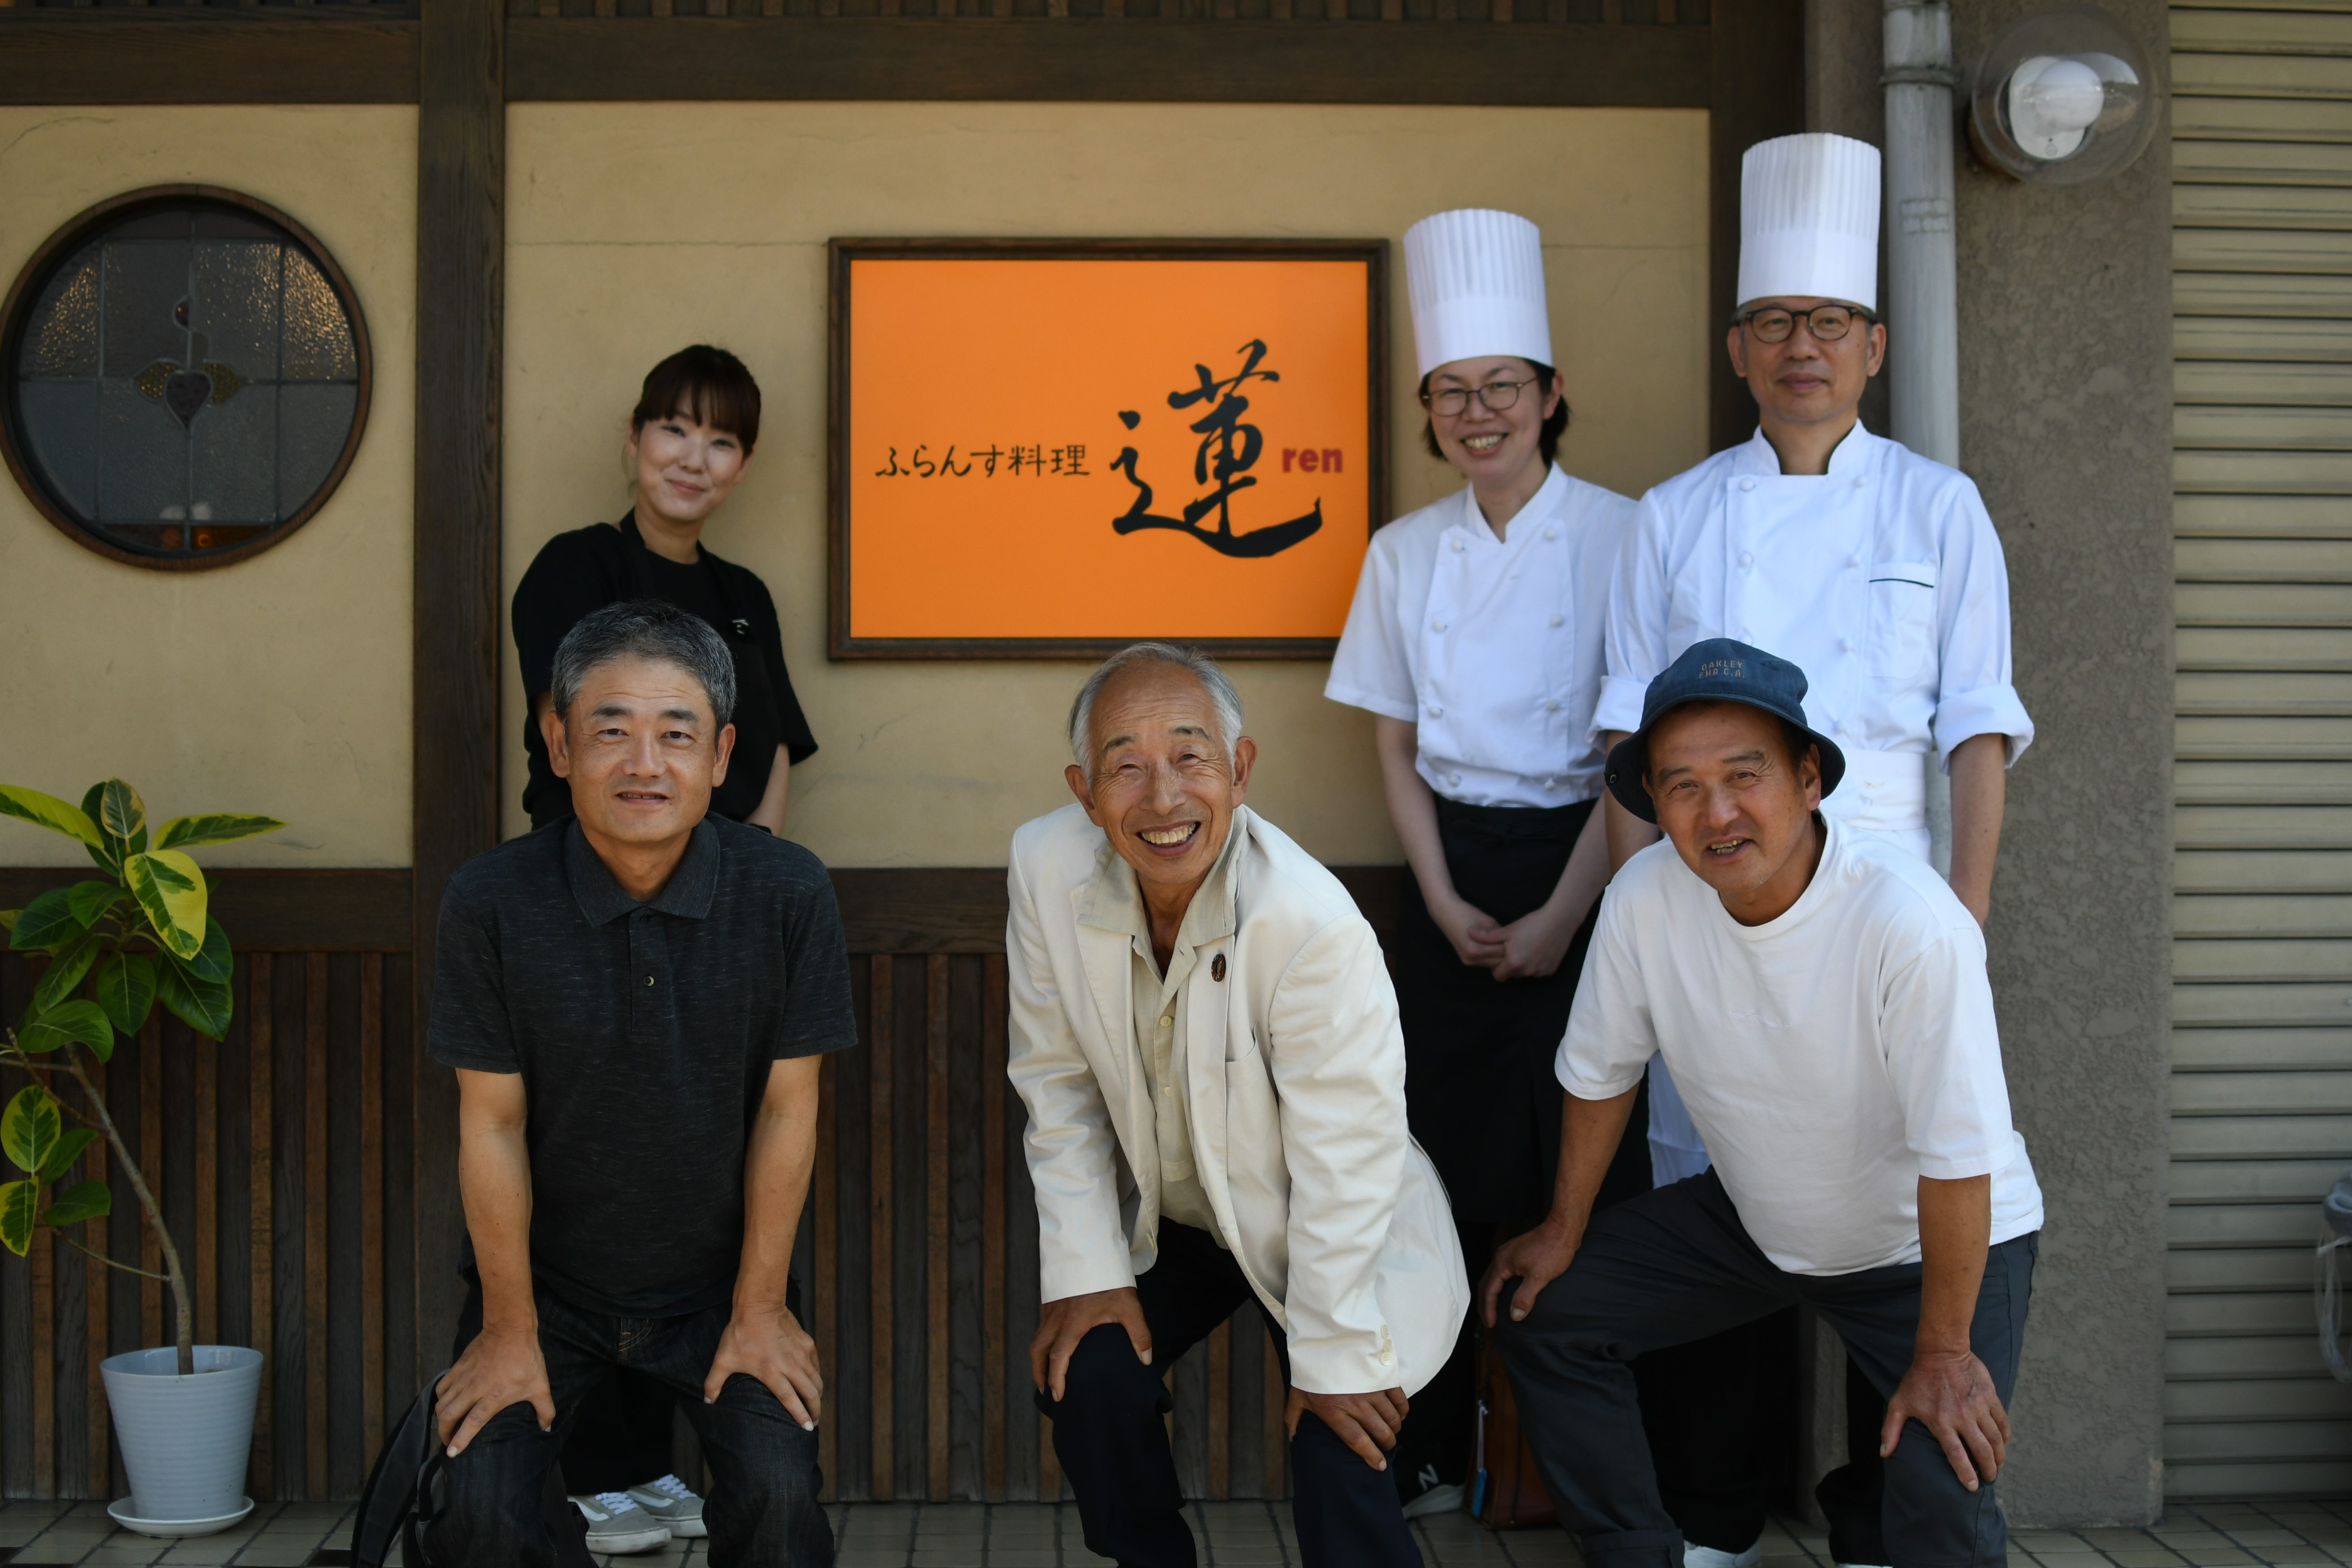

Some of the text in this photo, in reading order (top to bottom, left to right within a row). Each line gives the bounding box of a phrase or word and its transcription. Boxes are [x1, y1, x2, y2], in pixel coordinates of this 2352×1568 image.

[875, 338, 1322, 558] ふらんす料理 蓮
[1282, 448, 1343, 474] ren
[1699, 668, 1745, 678] FHR C.A.
[1701, 660, 1743, 671] OAKLEY
